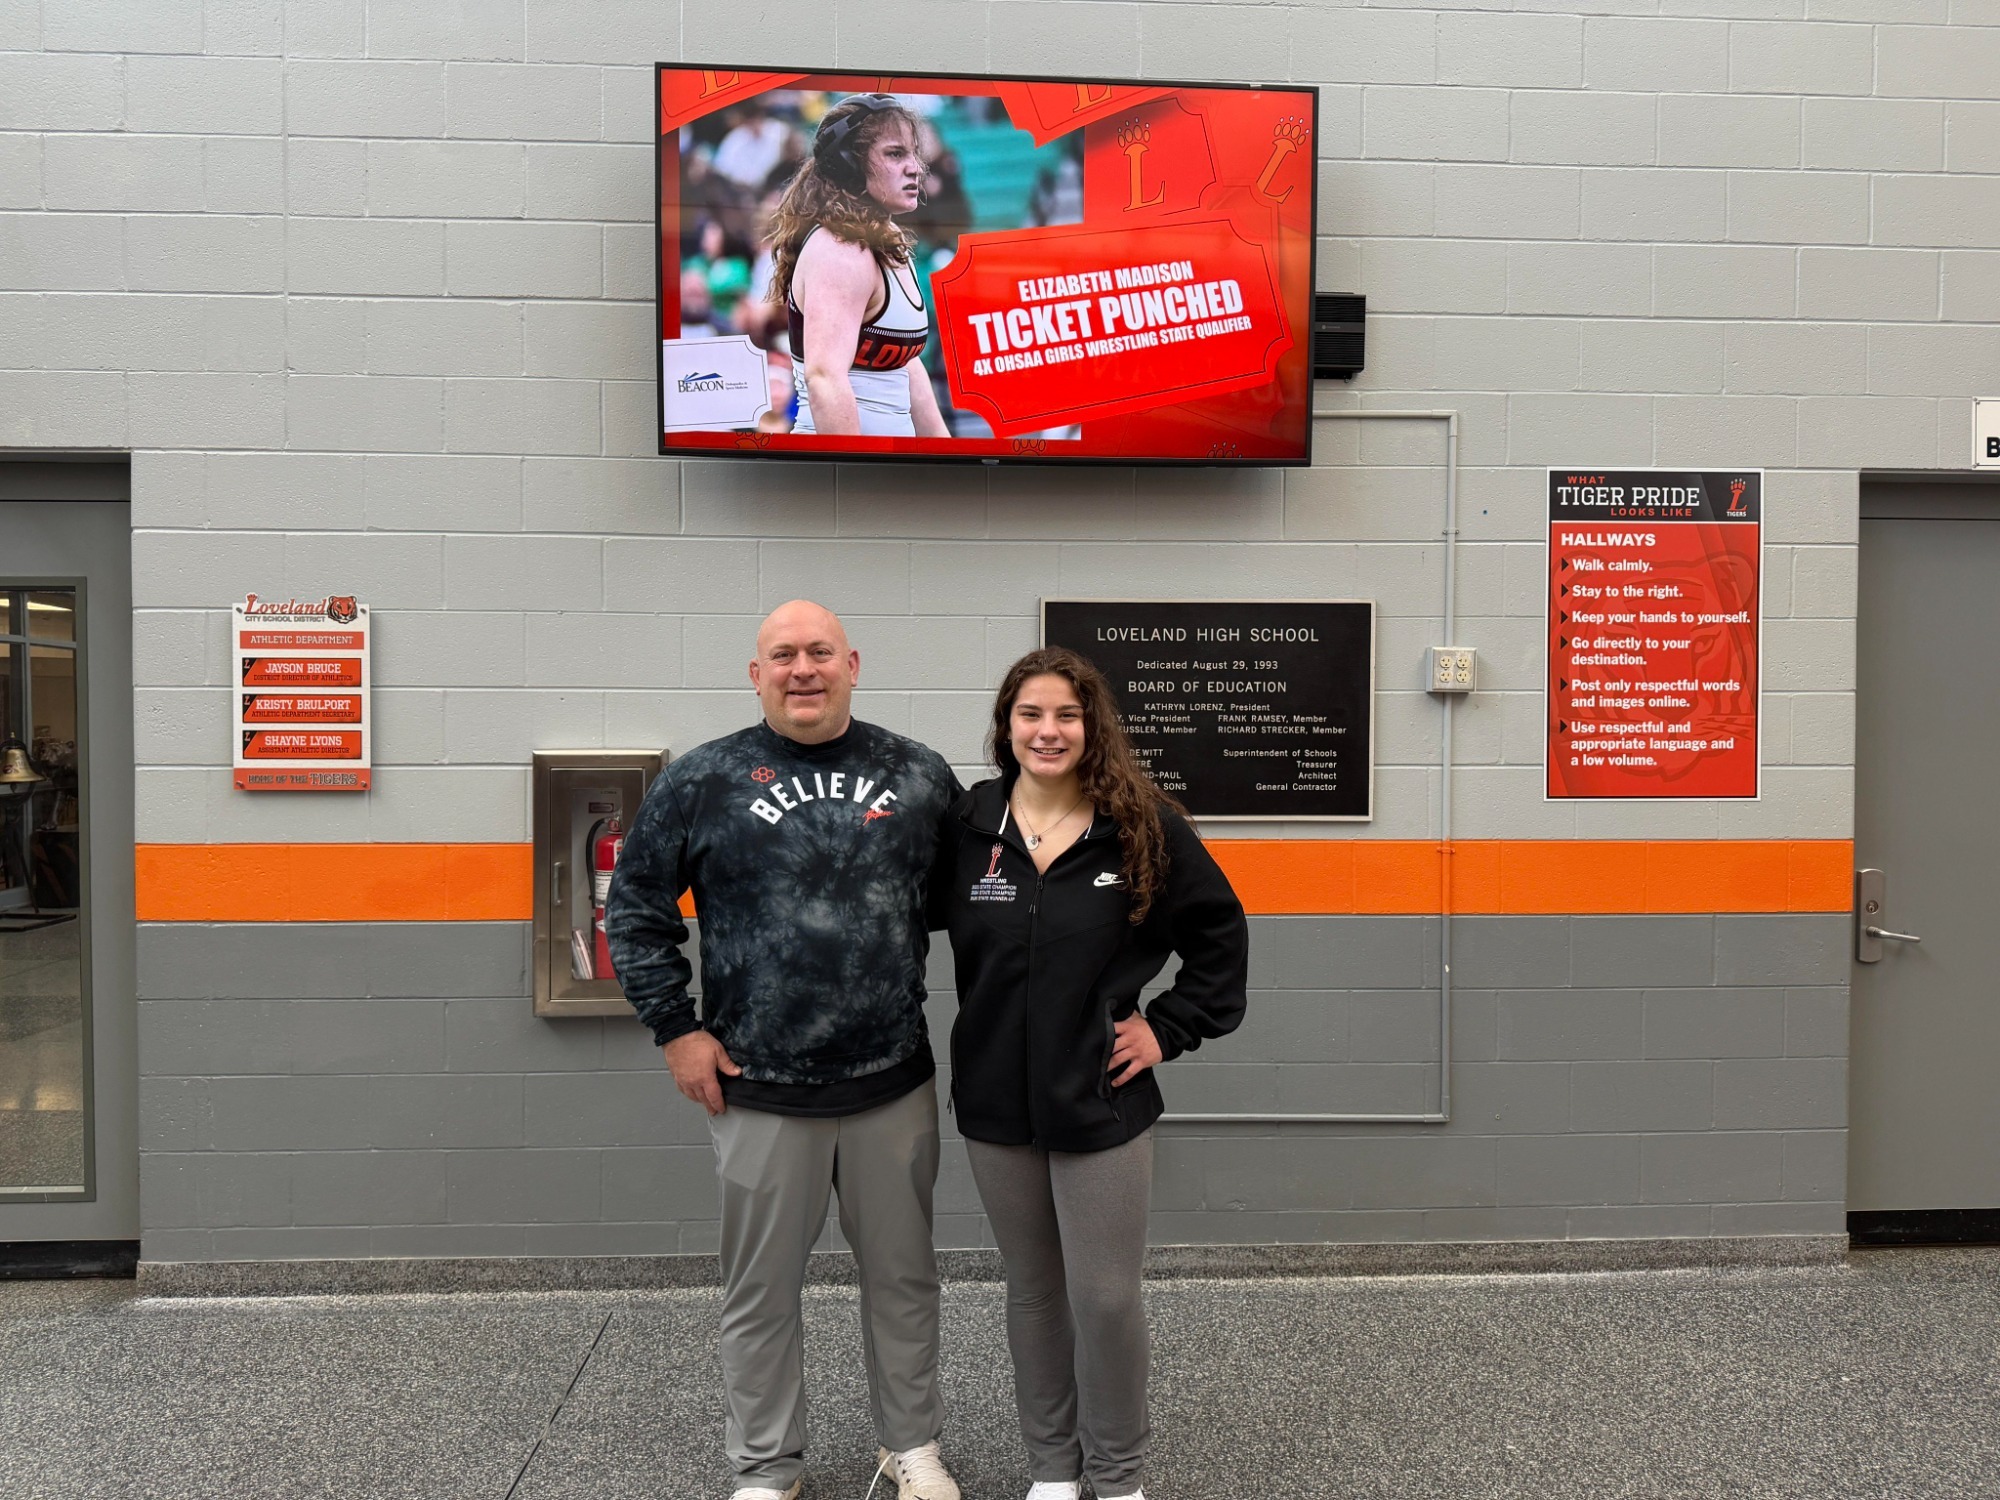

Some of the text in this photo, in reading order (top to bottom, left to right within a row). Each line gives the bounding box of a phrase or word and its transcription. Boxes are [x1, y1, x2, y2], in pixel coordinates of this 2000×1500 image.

[1018, 261, 1194, 302] ELIZABETH MADISON
[968, 279, 1244, 354] TICKET PUNCHED
[973, 316, 1252, 376] 4X OHSAA GIRLS WRESTLING STATE QUALIFIER
[678, 380, 724, 393] BEACON
[1987, 437, 2000, 458] B
[1567, 476, 1606, 484] WHAT
[1557, 487, 1700, 507] TIGER PRIDE
[1610, 508, 1692, 517] LOOKS LIKE
[1560, 533, 1656, 546] HALLWAYS
[1572, 559, 1653, 573] Walk calmly.
[1572, 585, 1683, 599] Stay to the right.
[244, 597, 327, 616] Loveland
[1572, 611, 1751, 624] Keep your hands to yourself.
[250, 636, 354, 644] ATHLETIC DEPARTMENT
[1097, 628, 1319, 642] LOVELAND HIGH SCHOOL
[1571, 637, 1691, 650] Go directly to your
[1571, 653, 1647, 665] destination.
[265, 664, 341, 673] JAYSON BRUCE
[1137, 660, 1279, 672] Dedicated August 29, 1993
[1128, 681, 1287, 693] BOARD OF EDUCATION
[1571, 679, 1741, 692] Post only respectful words
[256, 700, 352, 710] KRISTY BRULPORT
[1144, 703, 1270, 713] KATHRYN LORENZ, President
[1571, 695, 1691, 709] and images online.
[1128, 715, 1147, 723] Vice
[1150, 714, 1191, 723] President
[1218, 715, 1327, 724] FRANK RAMSEY, Member
[1163, 726, 1197, 734] Member
[1218, 726, 1347, 736] RICHARD STRECKER, Member
[1571, 721, 1691, 734] Use respectful and
[265, 736, 342, 746] SHAYNE LYONS
[1571, 737, 1734, 751] appropriate language and
[1223, 749, 1337, 759] Superintendent of Schools
[1571, 754, 1657, 766] a low volume.
[1296, 761, 1337, 769] Treasurer
[309, 773, 358, 785] TIGERS
[1298, 772, 1337, 780] Architect
[1256, 783, 1337, 791] General Contractor
[749, 772, 898, 825] BELIEVE
